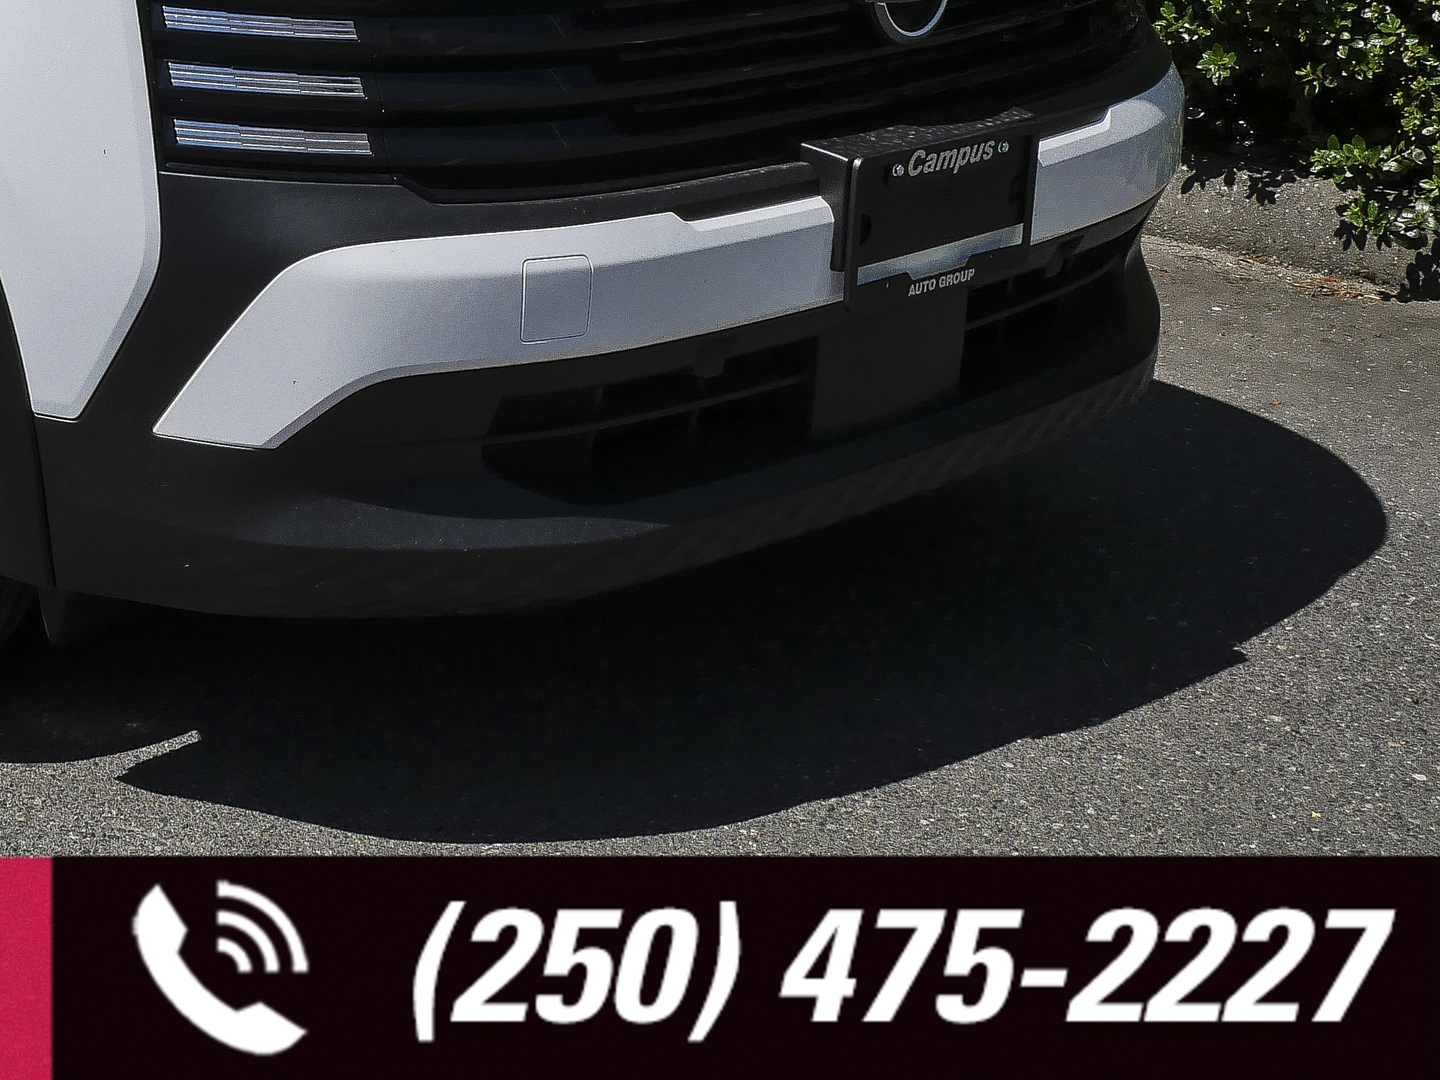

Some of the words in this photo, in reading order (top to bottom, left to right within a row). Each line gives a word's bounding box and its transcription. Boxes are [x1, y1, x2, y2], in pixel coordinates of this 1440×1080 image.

[907, 139, 996, 177] Campus
[908, 278, 936, 297] AUTO
[938, 268, 976, 288] GROUP
